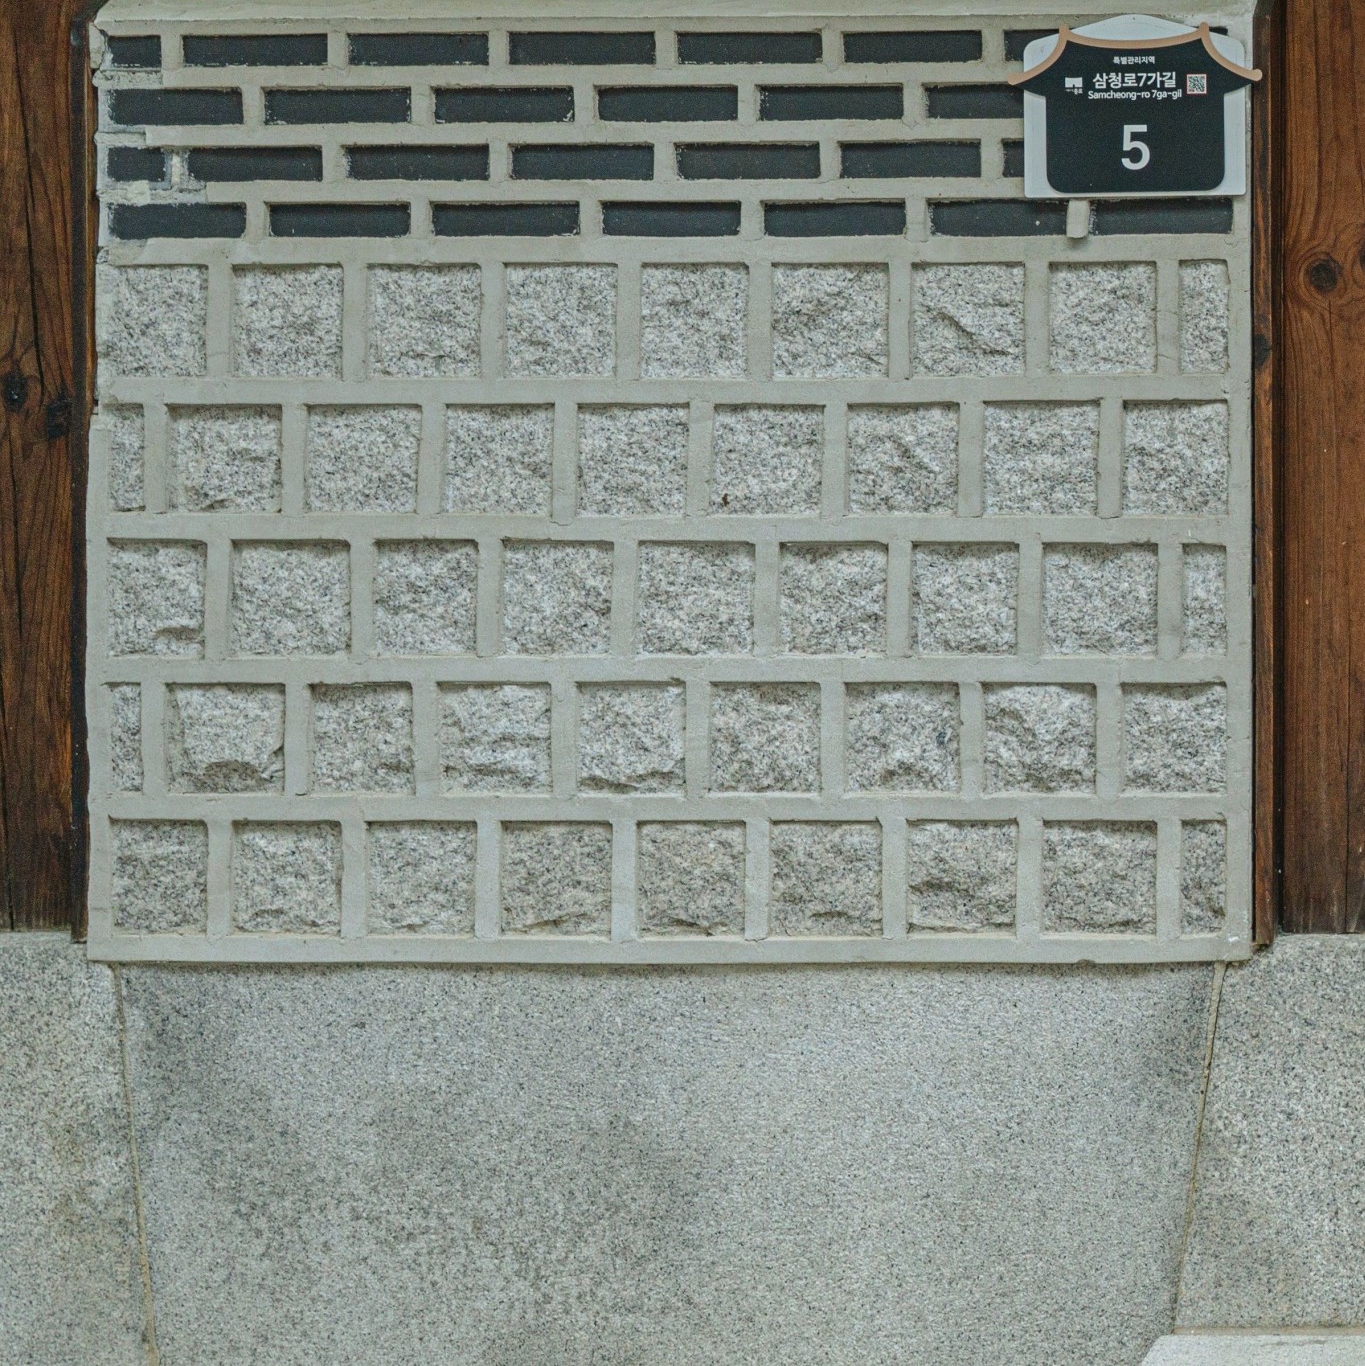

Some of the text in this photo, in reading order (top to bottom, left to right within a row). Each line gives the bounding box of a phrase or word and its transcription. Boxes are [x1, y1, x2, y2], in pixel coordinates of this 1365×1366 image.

[1112, 55, 1156, 65] 특별관리지역
[1092, 71, 1177, 89] 삼청로7가길
[1088, 90, 1150, 101] Samcheong-ro
[1151, 89, 1182, 100] 7ga-gil
[1121, 124, 1151, 171] 5
